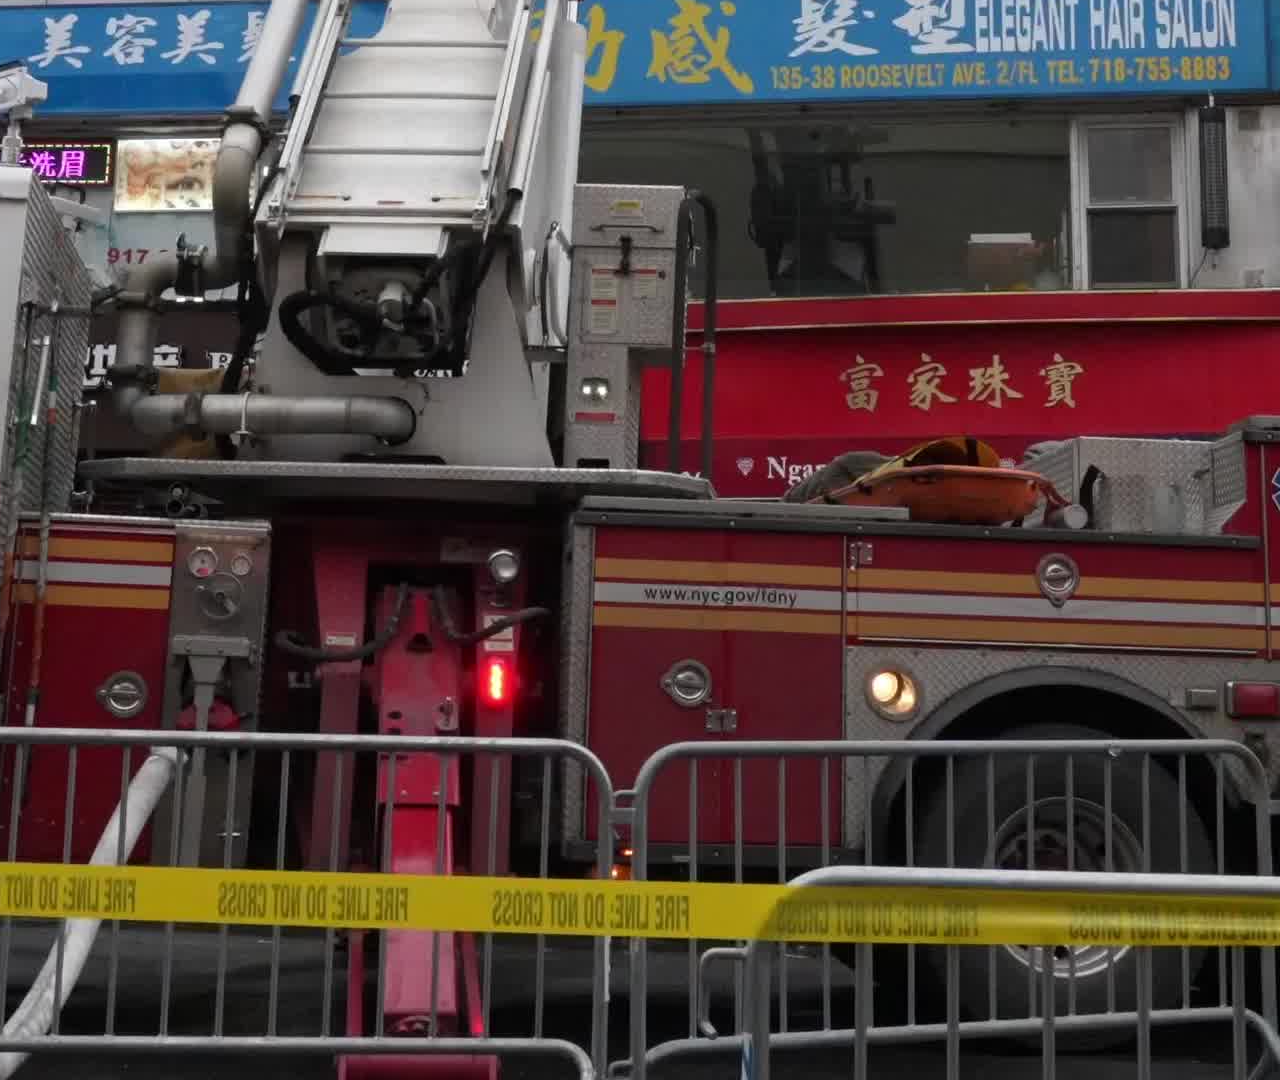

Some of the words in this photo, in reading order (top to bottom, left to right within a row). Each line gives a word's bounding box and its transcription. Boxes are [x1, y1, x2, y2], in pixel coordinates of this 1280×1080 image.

[769, 64, 836, 90] 135-38
[839, 62, 946, 89] ROOSEVELT
[951, 61, 991, 87] AVE.
[996, 59, 1039, 85] 2/FL
[1046, 58, 1084, 84] TEL:
[837, 351, 1085, 412] 富家珠寶
[643, 586, 798, 608] www.nyc.gov/fdny
